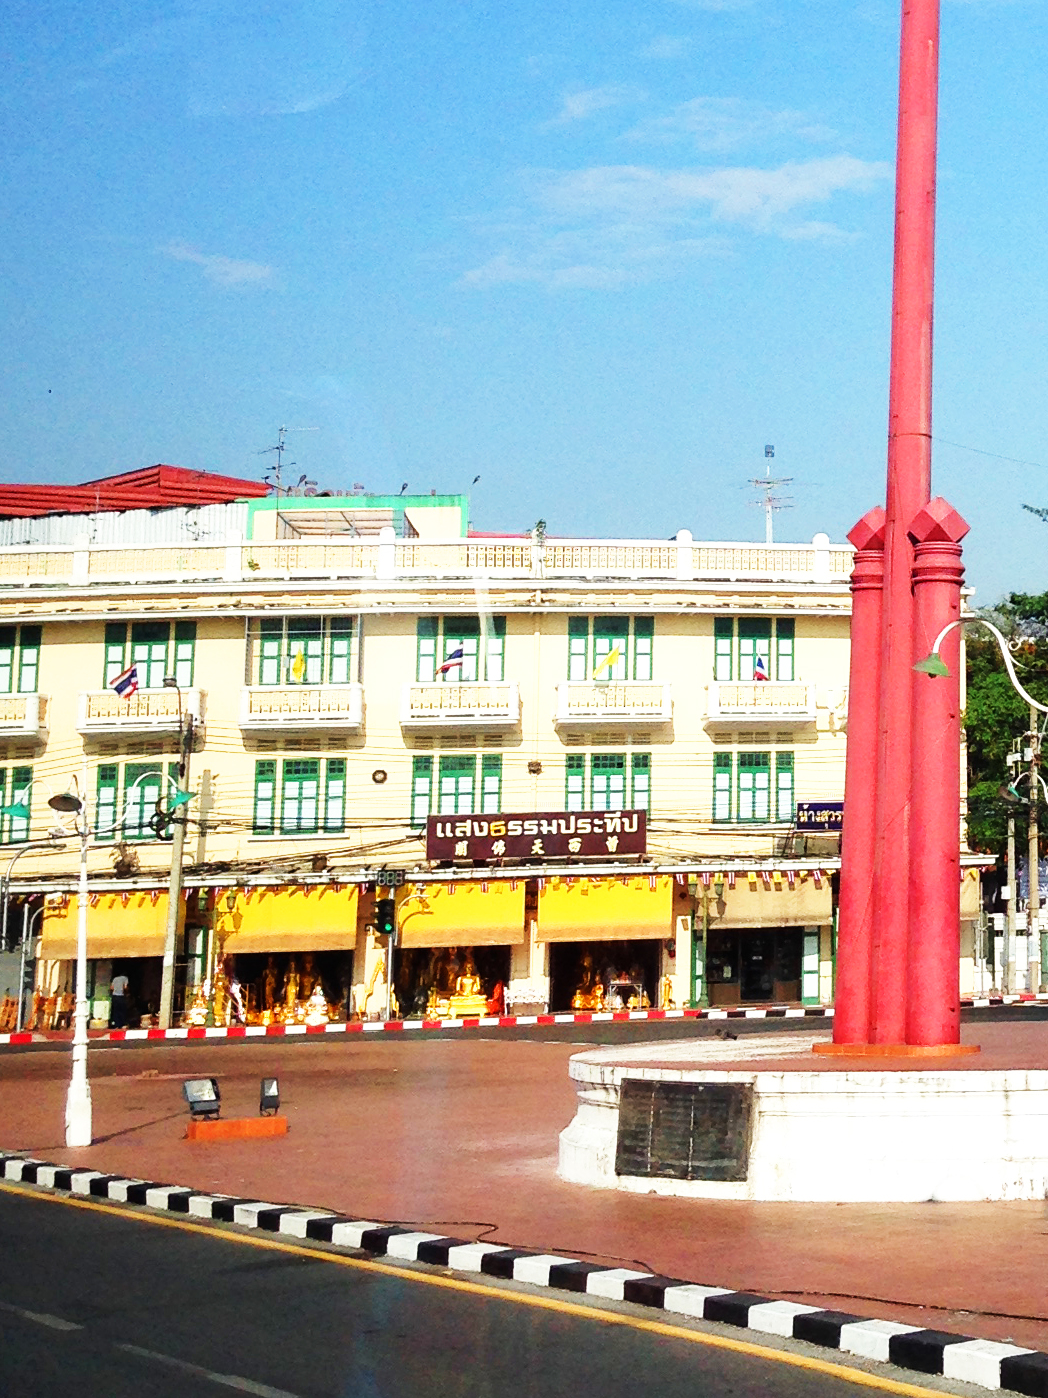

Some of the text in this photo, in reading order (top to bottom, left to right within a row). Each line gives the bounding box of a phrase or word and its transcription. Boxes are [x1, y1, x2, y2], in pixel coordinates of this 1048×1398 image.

[436, 811, 639, 838] แสงธรรมประทีป
[799, 803, 844, 829] ห้างสุวร
